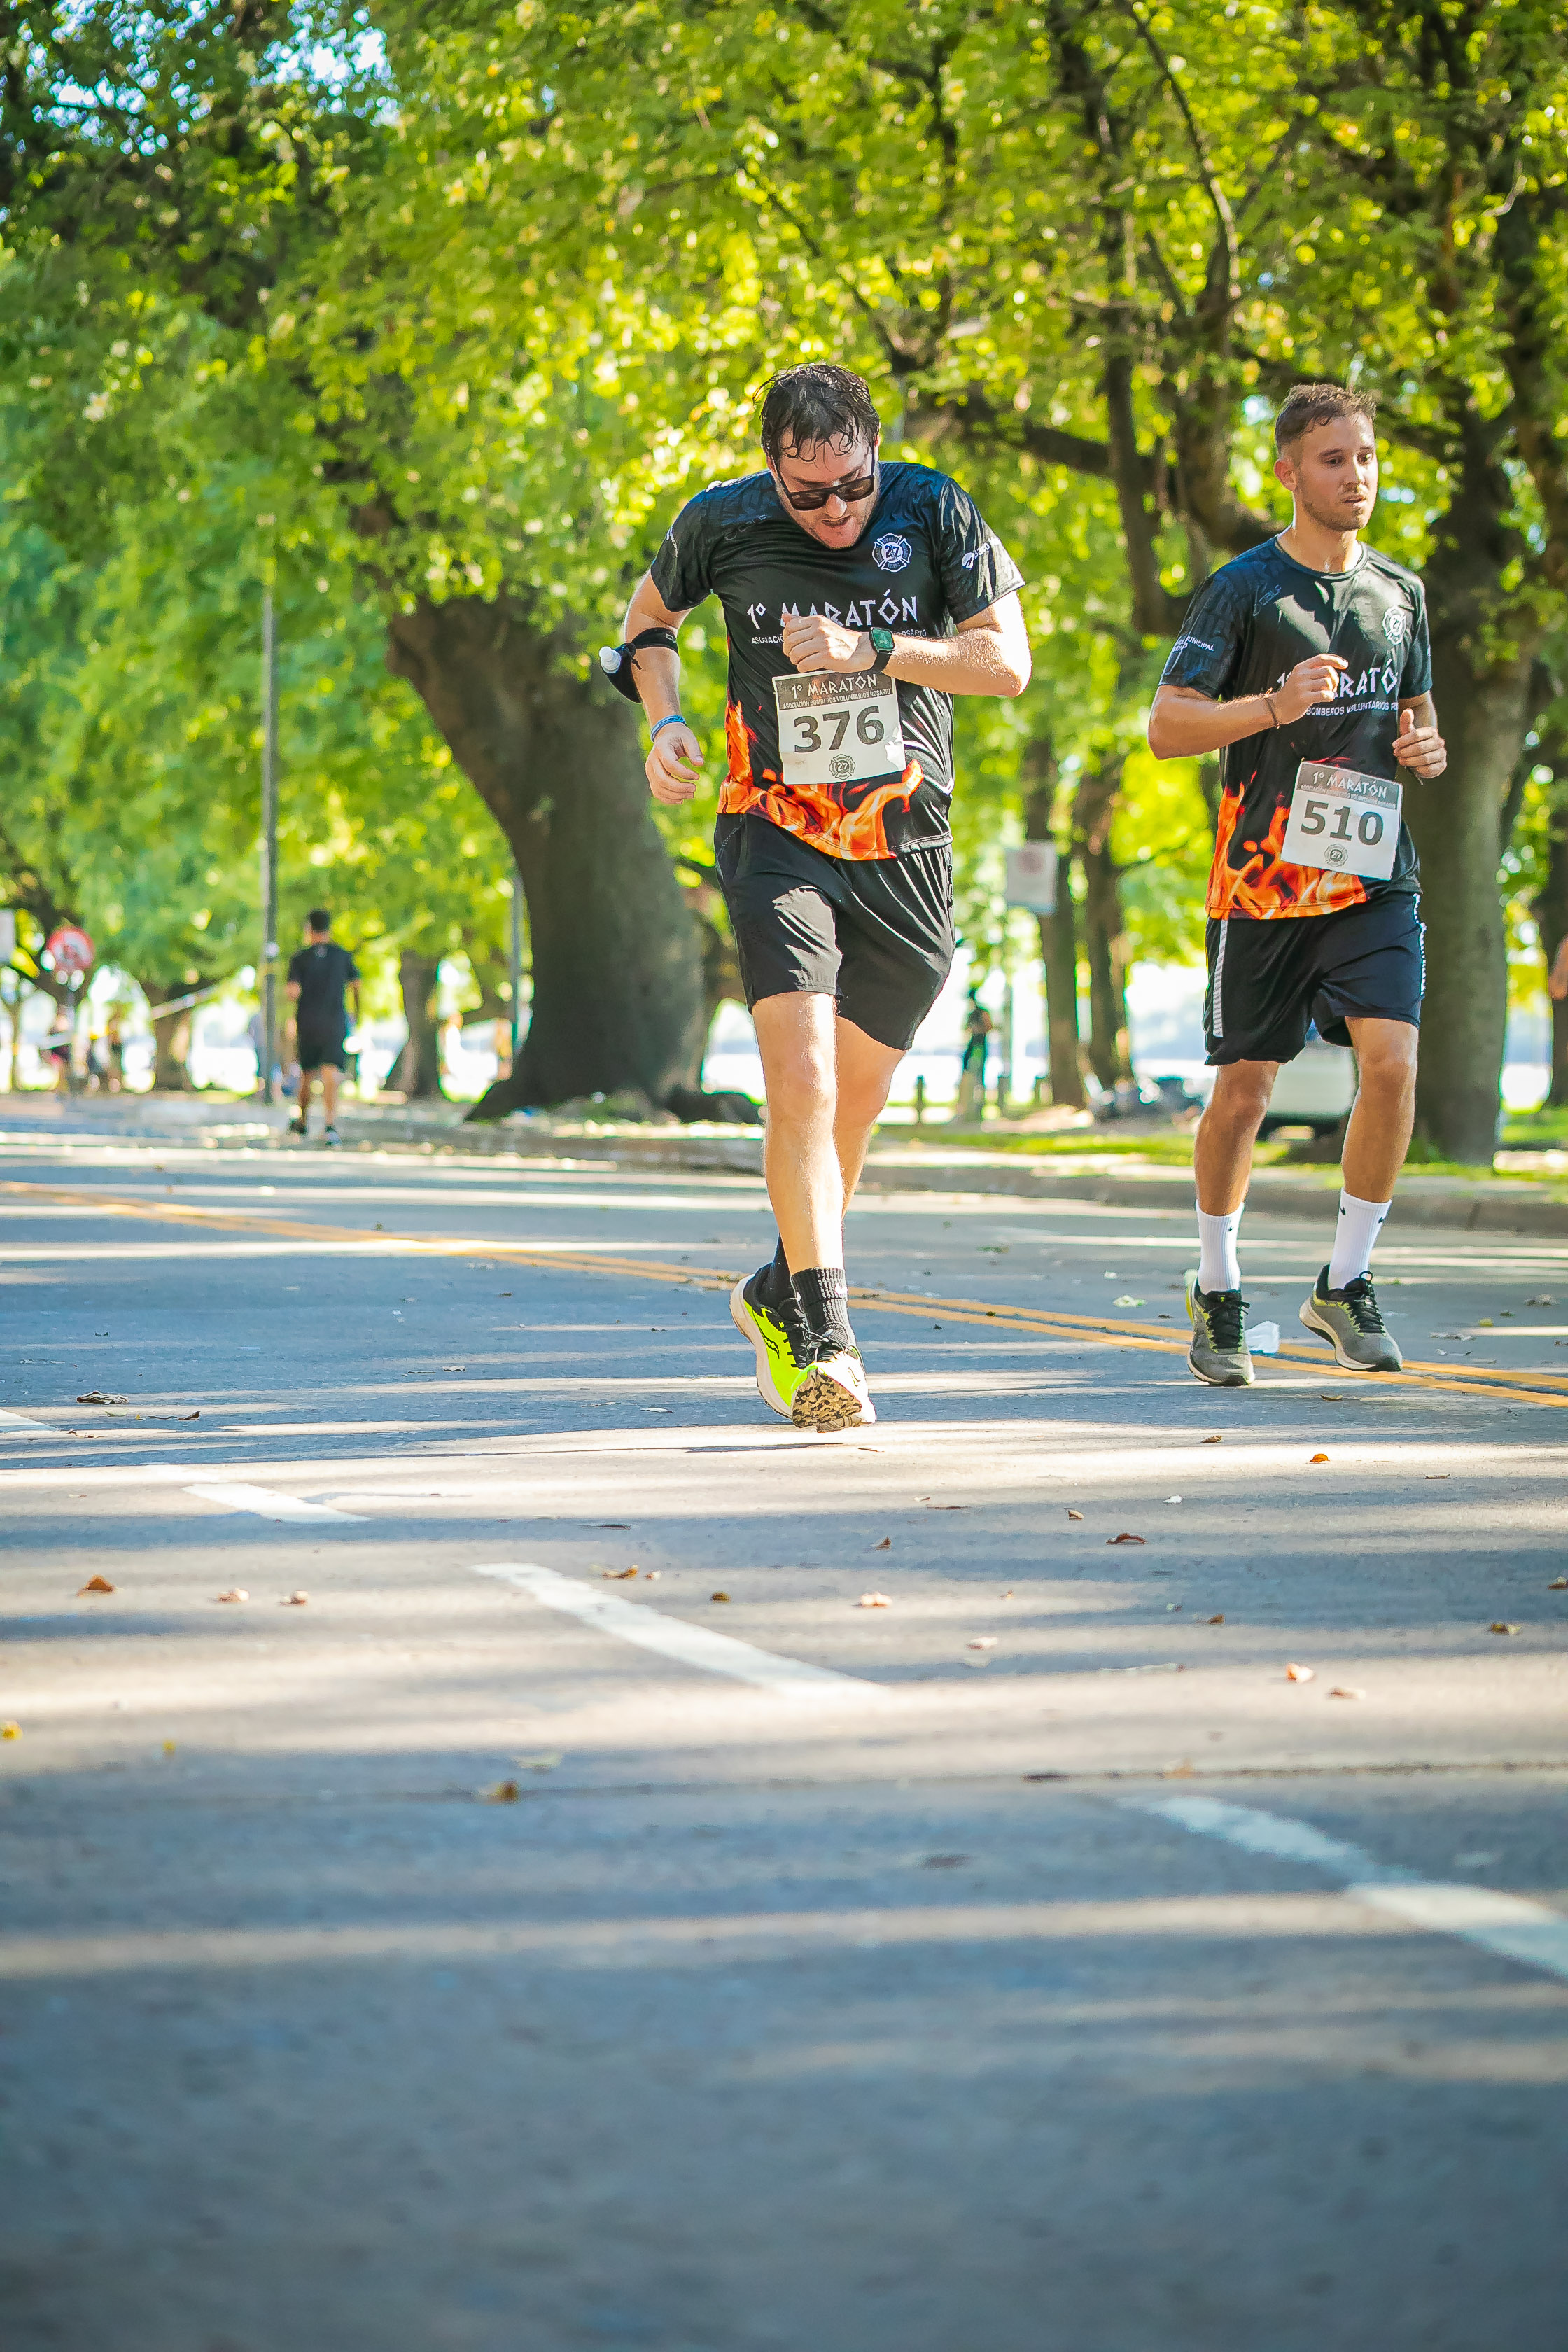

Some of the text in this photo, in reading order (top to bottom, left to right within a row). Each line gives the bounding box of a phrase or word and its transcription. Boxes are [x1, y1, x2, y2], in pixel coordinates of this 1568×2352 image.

[751, 634, 784, 645] ASOCIACIÓ
[808, 672, 877, 696] MARATÓN
[1334, 659, 1399, 699] RATÓ
[783, 689, 891, 709] ASOCIACIÓN BOMBEROS VOLUNTARIOS ROSARIO
[1306, 706, 1345, 716] BOMBEROS
[1346, 701, 1389, 714] VOLUNTARIOS
[794, 706, 884, 752] 376
[837, 762, 848, 771] 27
[1326, 774, 1387, 799] MARATÓN
[1301, 799, 1384, 846] 510
